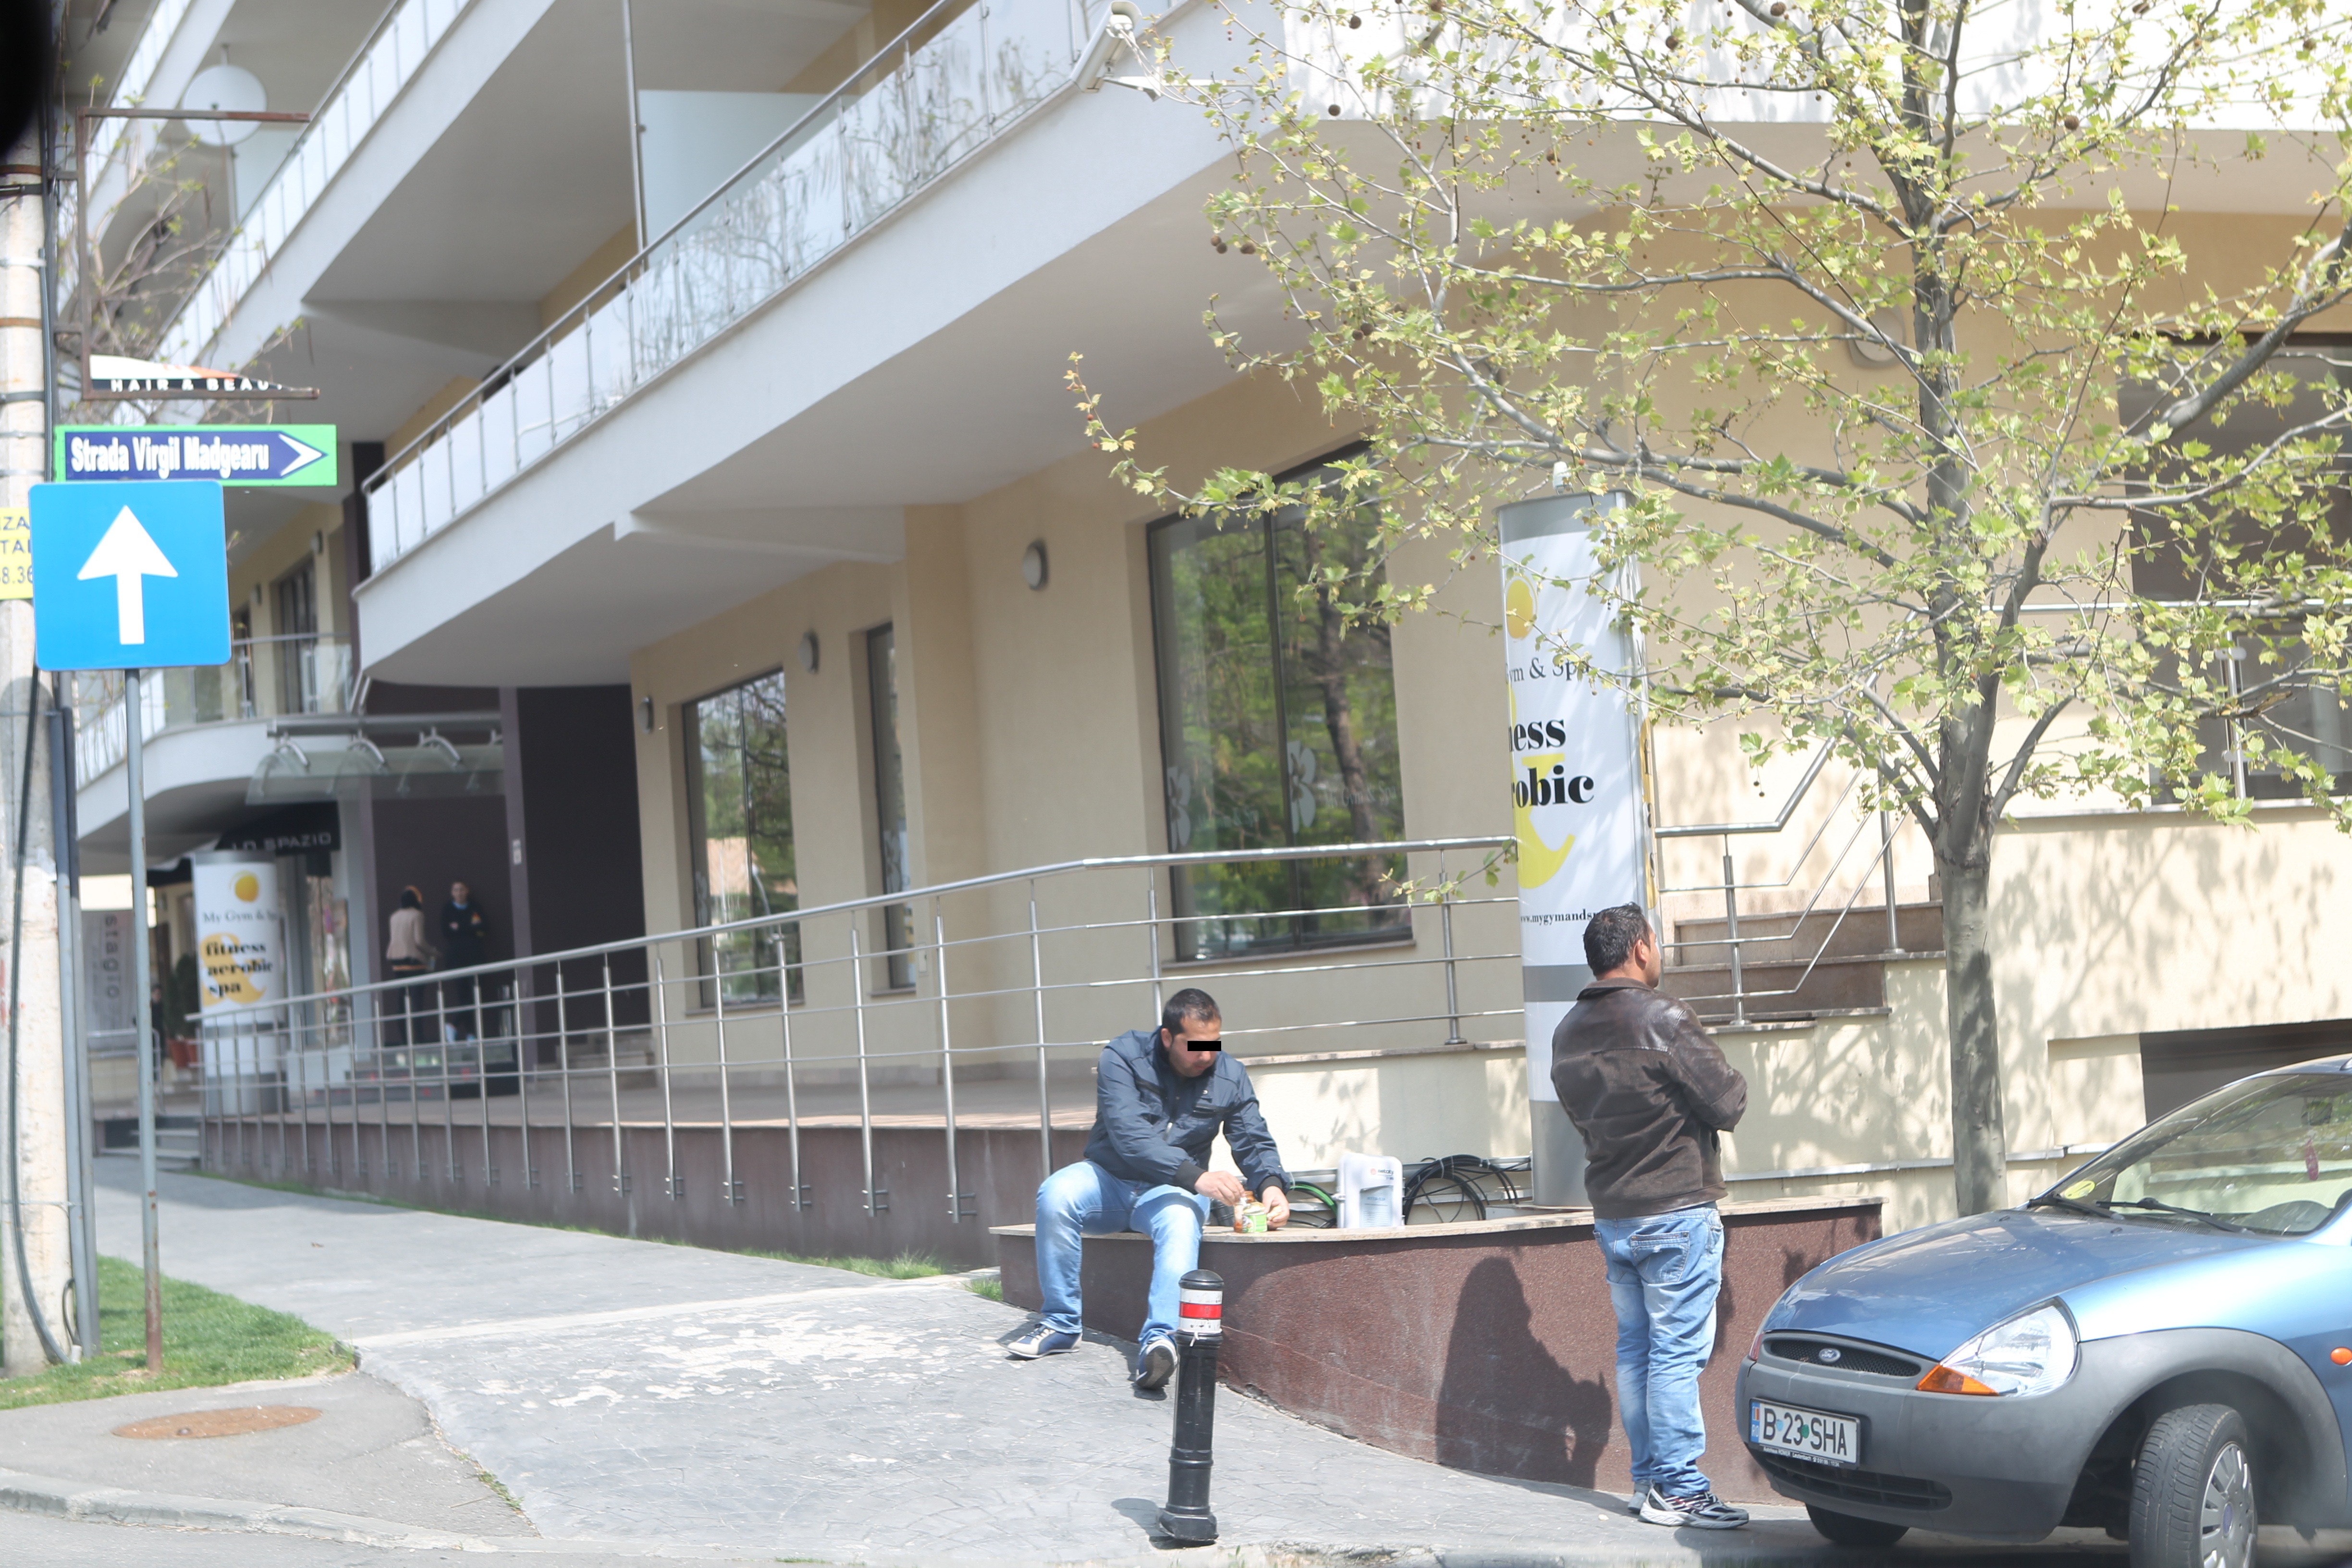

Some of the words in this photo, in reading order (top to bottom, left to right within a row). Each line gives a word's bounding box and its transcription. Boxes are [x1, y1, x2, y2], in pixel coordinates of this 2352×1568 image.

[110, 379, 169, 392] HAIR
[207, 378, 282, 392] BEAU
[71, 436, 129, 472] Strada
[133, 436, 180, 479] Virgil
[184, 436, 269, 479] Madgearu
[1530, 657, 1546, 679] &
[265, 832, 331, 851] SPAZIO
[204, 911, 220, 924] My
[225, 911, 253, 923] Gym
[206, 941, 266, 956] fitness
[208, 958, 273, 976] aerobic
[209, 982, 242, 998] spa
[1763, 1408, 1776, 1441] B
[1782, 1412, 1804, 1446] 23
[1810, 1417, 1847, 1456] SHA
